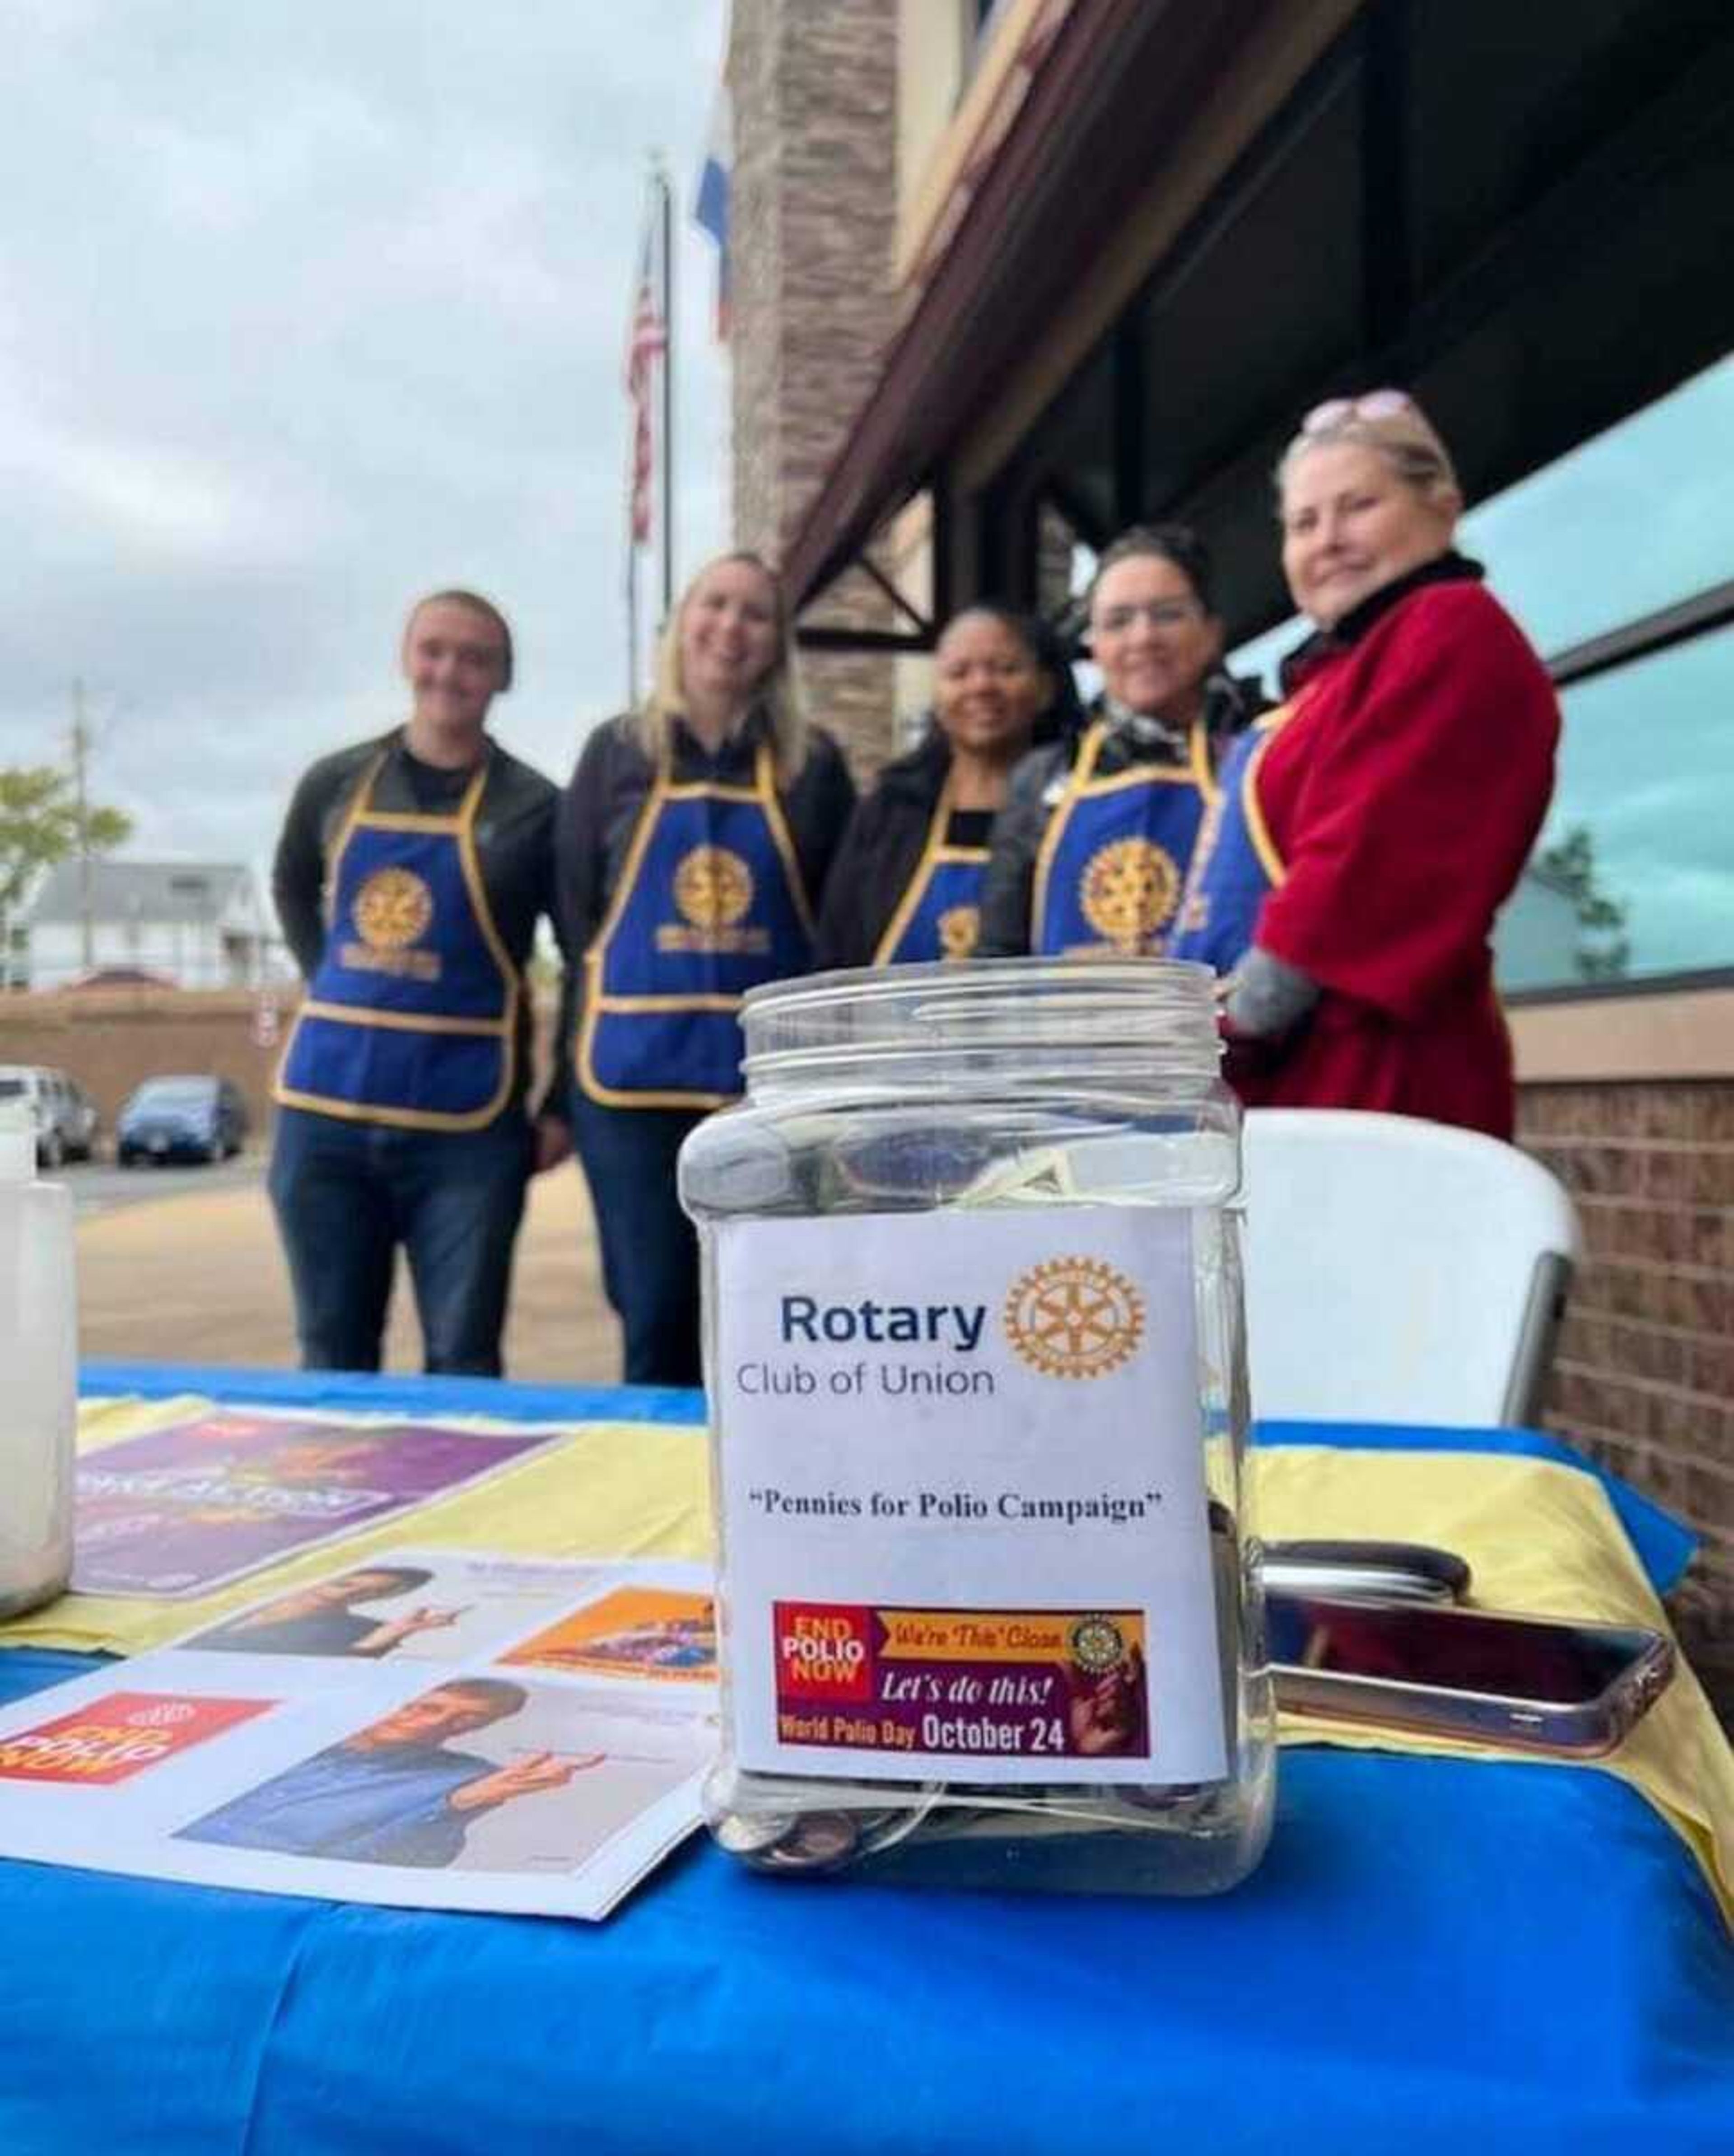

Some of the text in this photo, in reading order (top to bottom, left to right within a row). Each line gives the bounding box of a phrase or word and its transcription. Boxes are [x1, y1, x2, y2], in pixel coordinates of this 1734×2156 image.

[780, 1295, 987, 1351] Rotary
[737, 1362, 994, 1395] Club of Union
[750, 1490, 1162, 1524] “Pennies for Polio Campaign”
[794, 1616, 852, 1639] END
[782, 1638, 865, 1661] POLIO
[790, 1661, 856, 1683] NOW
[881, 1672, 1053, 1706] Let's do this!
[4, 1735, 171, 1761] POLIO
[781, 1714, 1065, 1751] World Polio Day October 24
